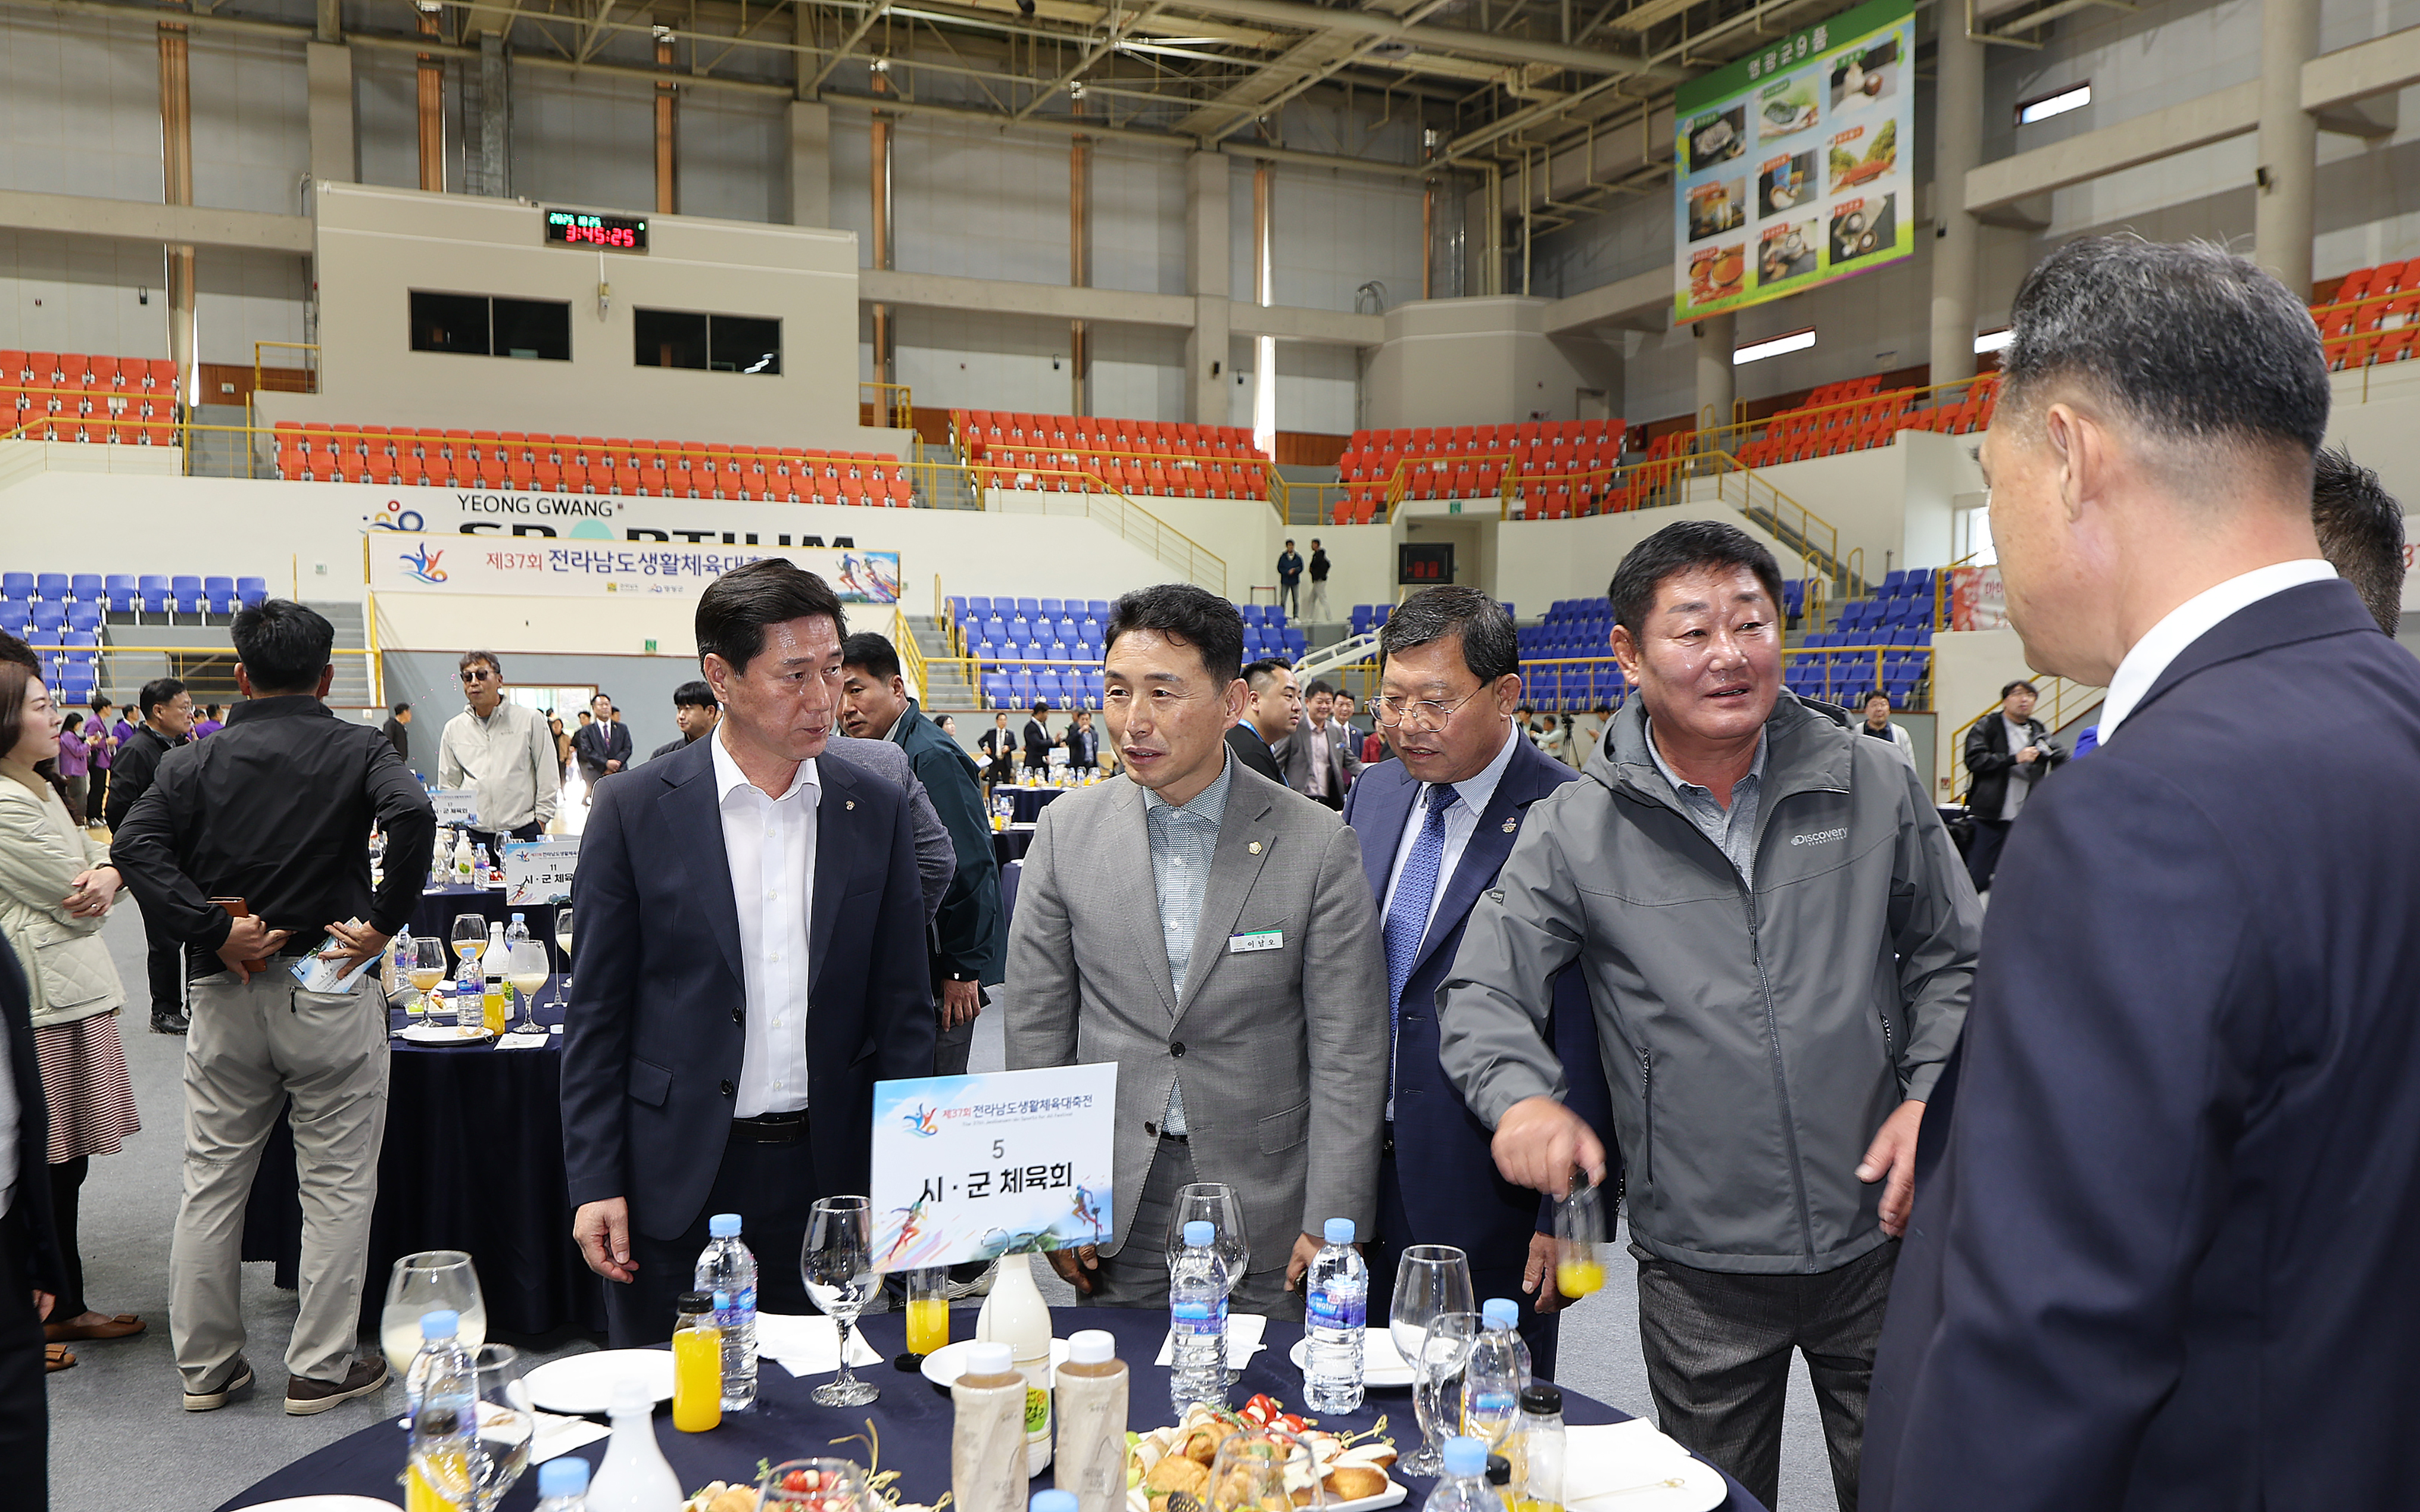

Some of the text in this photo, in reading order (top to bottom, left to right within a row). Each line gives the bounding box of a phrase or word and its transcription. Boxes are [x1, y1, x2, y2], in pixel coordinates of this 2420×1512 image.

[566, 224, 635, 248] 3:45:25
[457, 493, 612, 517] YEONG GWANG
[486, 551, 543, 571] 제37회
[942, 1094, 1093, 1119] 제37회 전라남도생활체육대축전
[992, 1139, 1005, 1159] 5
[1000, 1161, 1072, 1194] 체육회
